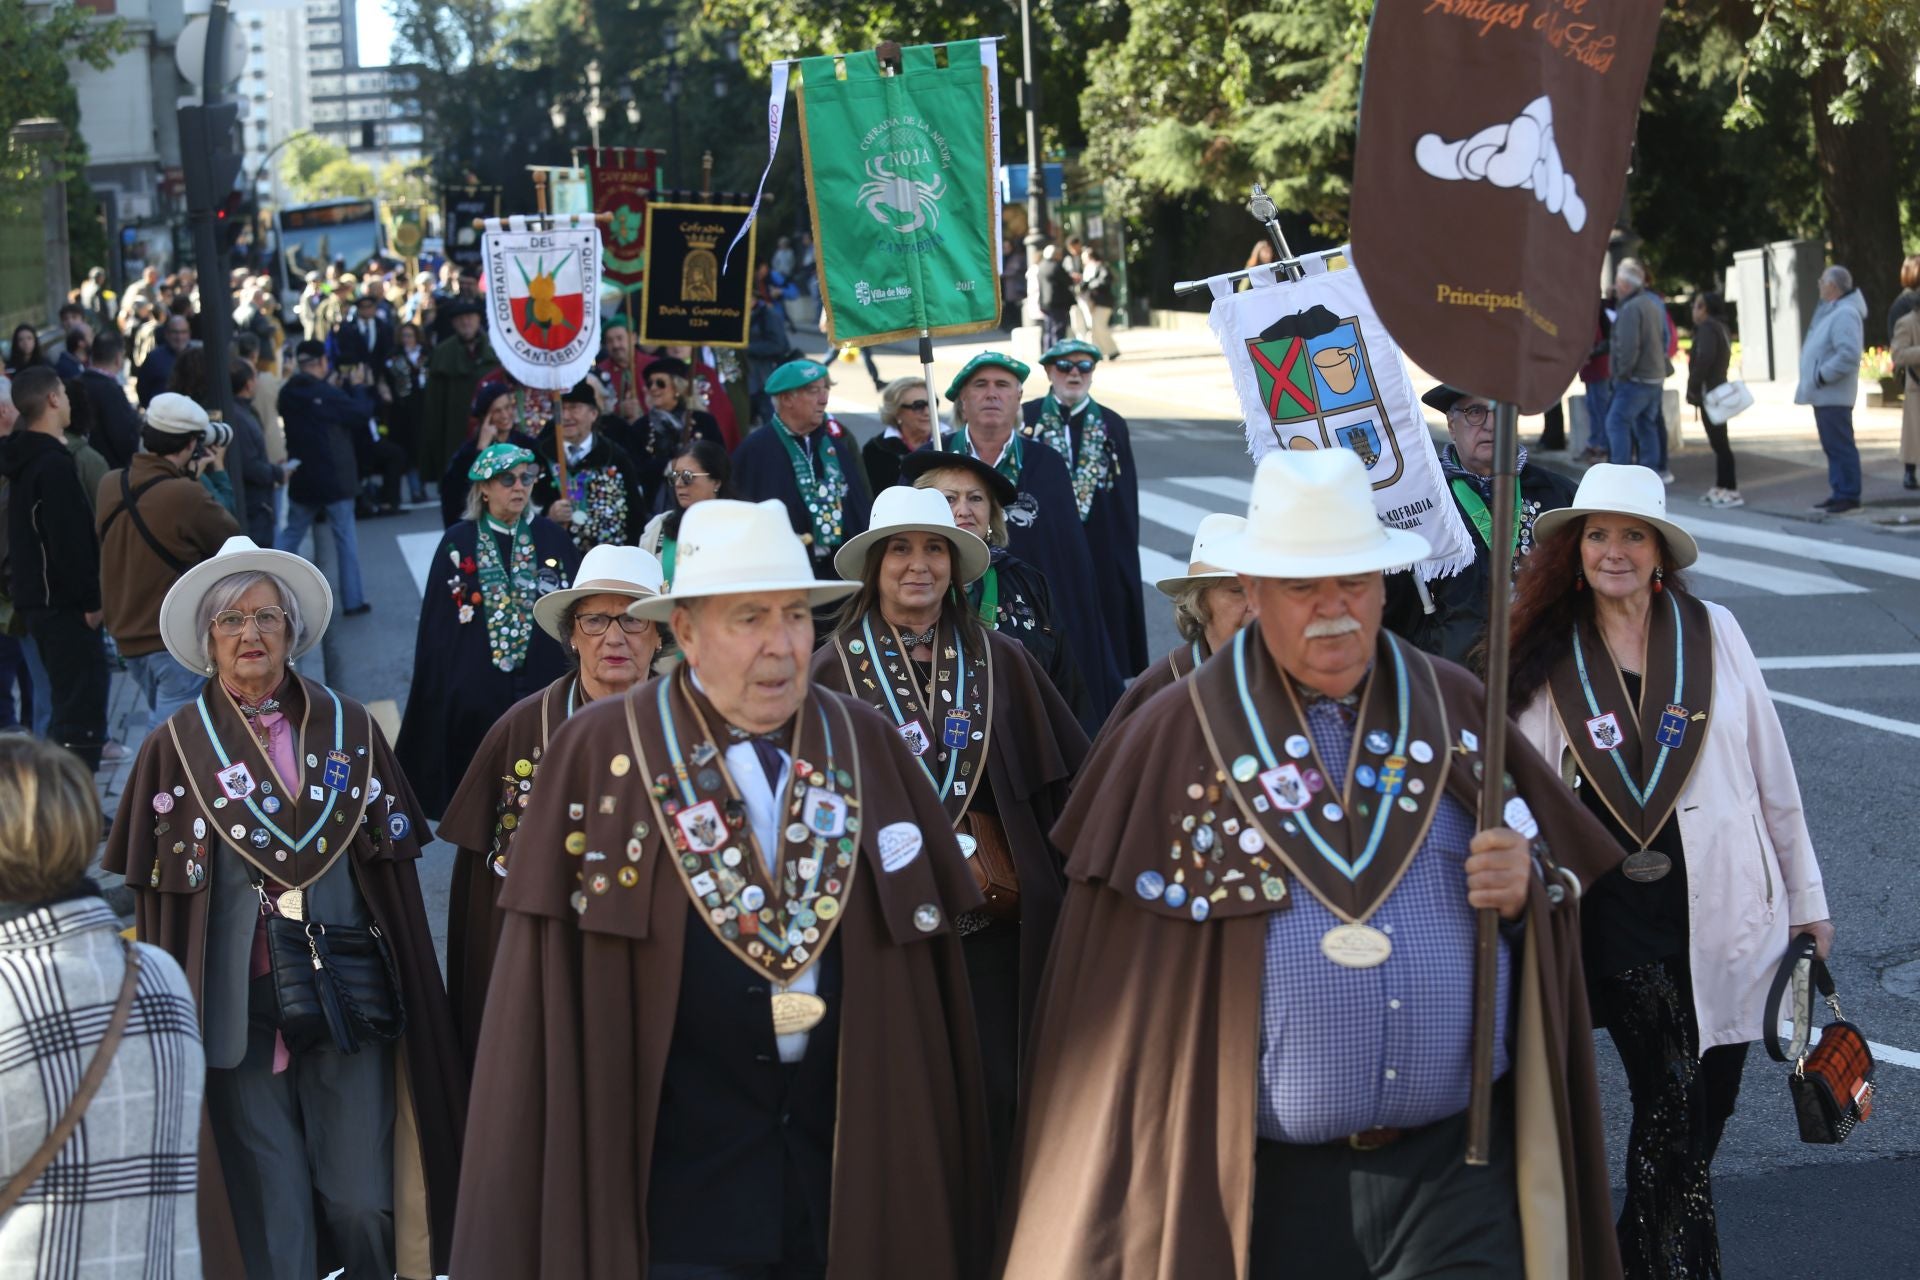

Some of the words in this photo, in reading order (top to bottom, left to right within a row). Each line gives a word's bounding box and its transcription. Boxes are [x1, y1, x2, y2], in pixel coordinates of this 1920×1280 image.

[903, 115, 915, 125] DE
[917, 118, 929, 133] LA
[889, 148, 932, 167] NOJA
[530, 237, 555, 248] DEL
[582, 247, 593, 294] QUESO
[493, 251, 510, 322] COFRADIA
[887, 287, 896, 297] de
[896, 286, 912, 298] Noja
[956, 280, 976, 291] 2017
[1437, 284, 1525, 313] Principad
[584, 301, 592, 318] DE
[514, 338, 585, 364] CANTABRIA
[1386, 497, 1434, 522] KOFRADIA
